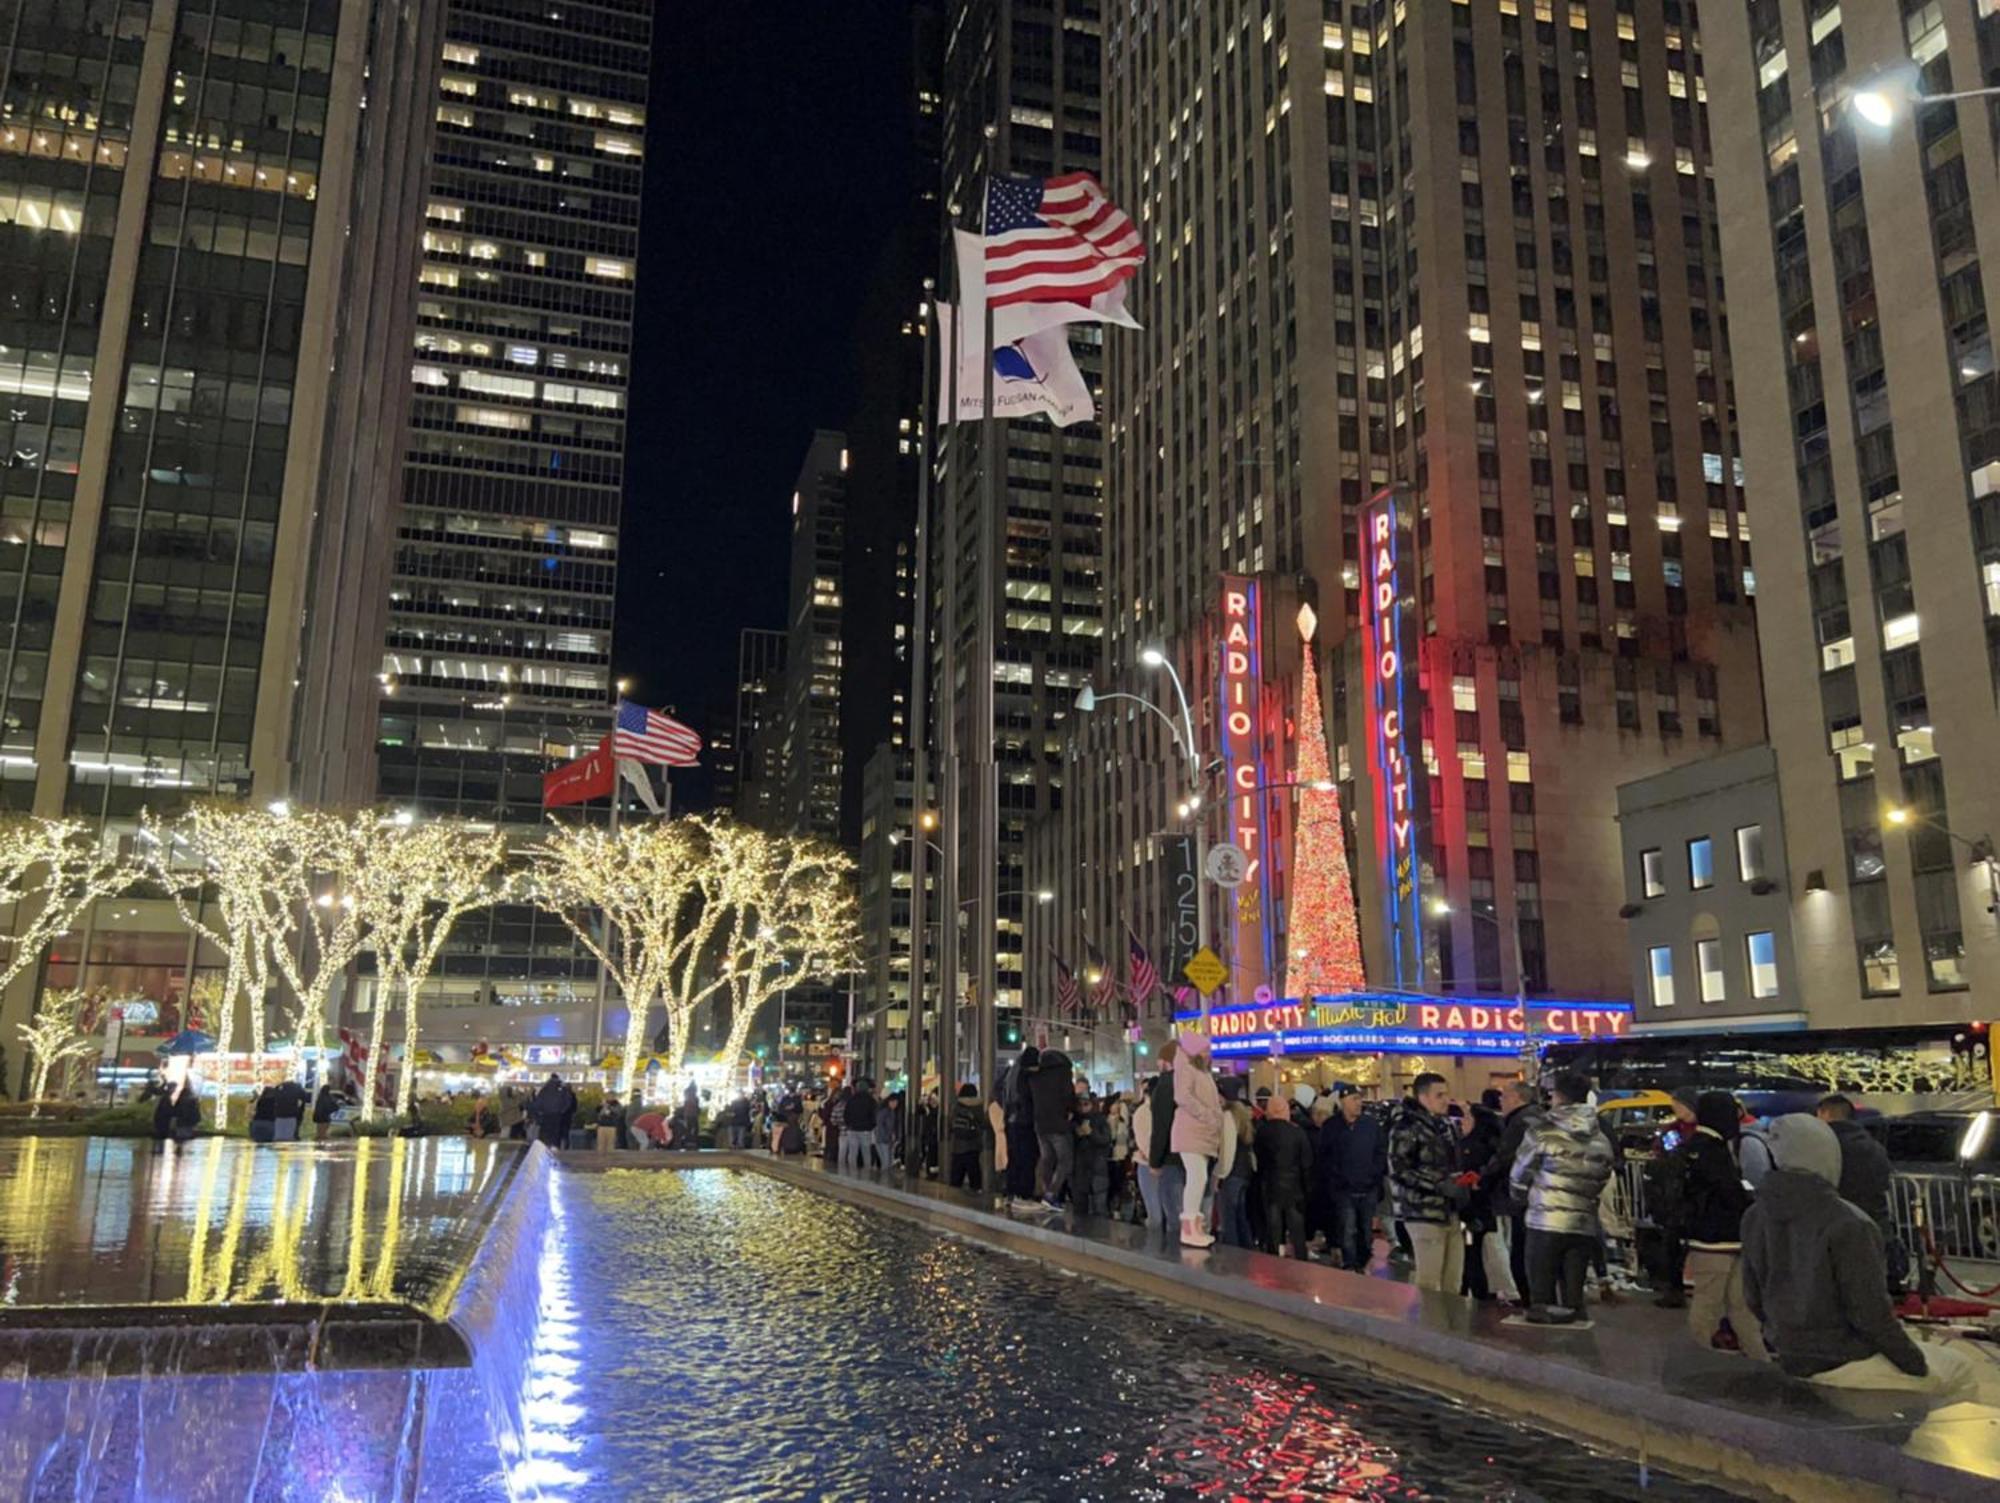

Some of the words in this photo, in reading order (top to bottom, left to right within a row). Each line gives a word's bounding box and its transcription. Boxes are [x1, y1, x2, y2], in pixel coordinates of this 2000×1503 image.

[1227, 592, 1251, 736] RADIO
[1376, 513, 1397, 679] RADIO
[1384, 710, 1410, 849] CITY
[1210, 1012, 1257, 1036] RADIO
[1264, 1005, 1305, 1030] CITY
[1420, 1005, 1525, 1030] RADIO
[1547, 1010, 1625, 1033] CITY
[1423, 1036, 1465, 1047] PLAYING
[1476, 1037, 1497, 1047] THIS
[1501, 1039, 1511, 1047] IS
